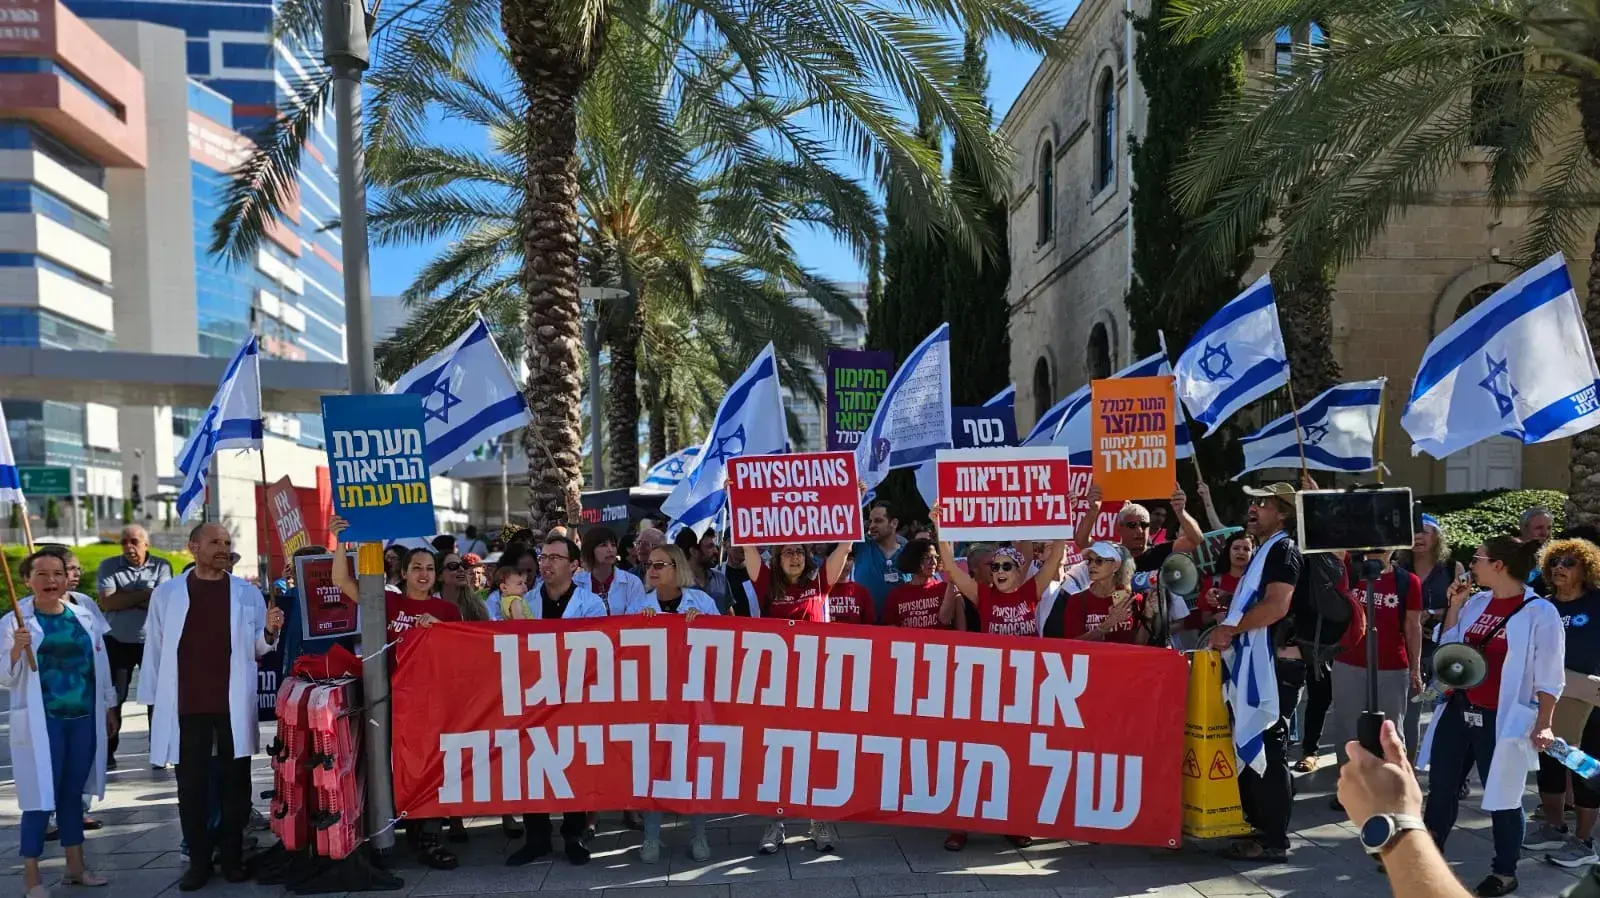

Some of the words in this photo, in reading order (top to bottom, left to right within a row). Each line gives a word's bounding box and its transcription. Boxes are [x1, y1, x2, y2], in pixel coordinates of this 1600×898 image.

[835, 368, 887, 389] המימון
[1101, 398, 1134, 413] לכולל
[1137, 397, 1166, 411] התור
[963, 418, 1005, 446] כסף
[1101, 413, 1166, 435] מתקצר
[332, 429, 422, 459] מערכת
[1101, 436, 1137, 450] לניתוח
[1139, 435, 1167, 448] התור
[335, 457, 425, 484] הבריאות
[736, 458, 849, 489] PHYSICIANS
[1101, 449, 1167, 473] מתארך
[956, 466, 1020, 492] בריאות
[1023, 465, 1051, 493] אין
[338, 482, 428, 508] מורעבת!
[771, 491, 820, 503] FOR
[1035, 492, 1067, 520] בלי
[737, 505, 854, 538] DEMOCRACY
[942, 496, 1032, 524] דמוקרטיה
[316, 586, 342, 595] חולה
[898, 596, 940, 614] PHYSICIANS
[494, 628, 667, 716] המגן
[682, 628, 873, 712] חומת
[891, 641, 1089, 728] אנחנו
[439, 724, 744, 804] הבריאות
[757, 728, 1011, 820] מערכת
[1029, 733, 1142, 829] של
